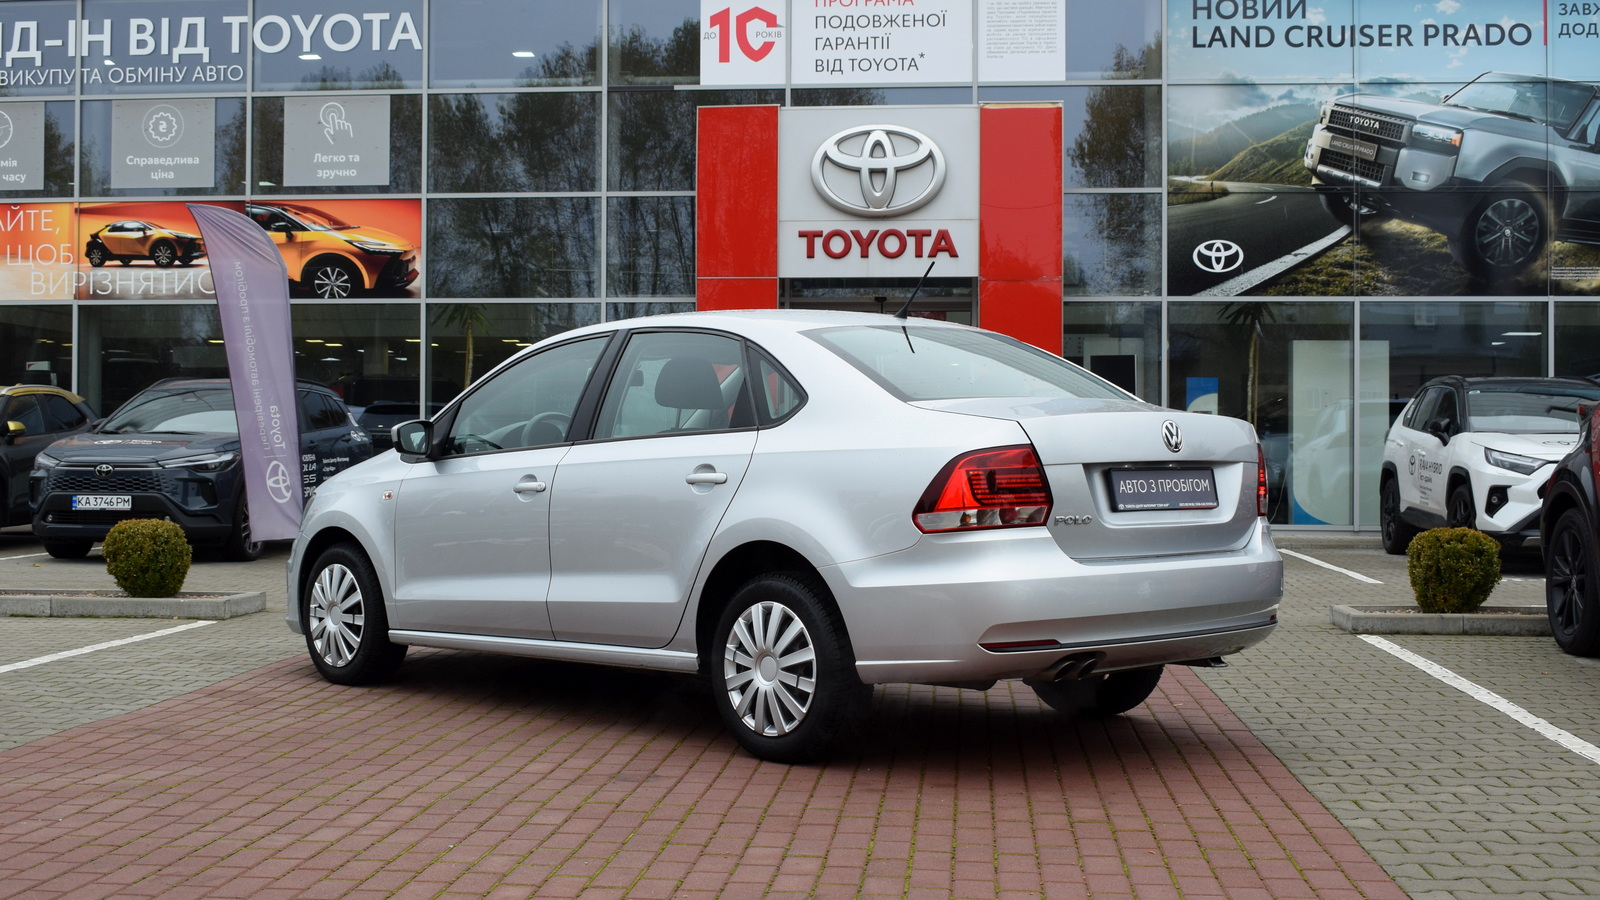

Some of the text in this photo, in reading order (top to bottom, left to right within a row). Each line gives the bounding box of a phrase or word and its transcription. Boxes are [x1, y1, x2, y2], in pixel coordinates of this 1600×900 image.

[815, 10, 948, 31] ПОДОВЖЕНОЇ
[0, 12, 423, 67] Д-ІН ВІД TOYOTA
[815, 33, 892, 51] ГАРАНТІЇ
[1192, 23, 1532, 48] LAND CRUISER PRADO
[815, 58, 844, 75] ВІД
[81, 68, 102, 84] ТА
[108, 66, 187, 83] ОБМІНУ
[192, 65, 244, 82] АВТО
[1350, 116, 1379, 129] TOYOTA
[126, 155, 200, 167] Справедлива
[313, 153, 360, 163] Легко та
[2, 173, 27, 184] часу
[151, 169, 175, 180] ціна
[316, 169, 357, 179] зручно
[798, 229, 959, 259] TOYOTA
[6, 243, 74, 270] ЩОБ
[1119, 480, 1148, 493] АВТО
[1158, 478, 1211, 493] ПРОБІГОМ
[77, 496, 131, 507] KA 3746 PM
[1054, 515, 1093, 526] POLO
